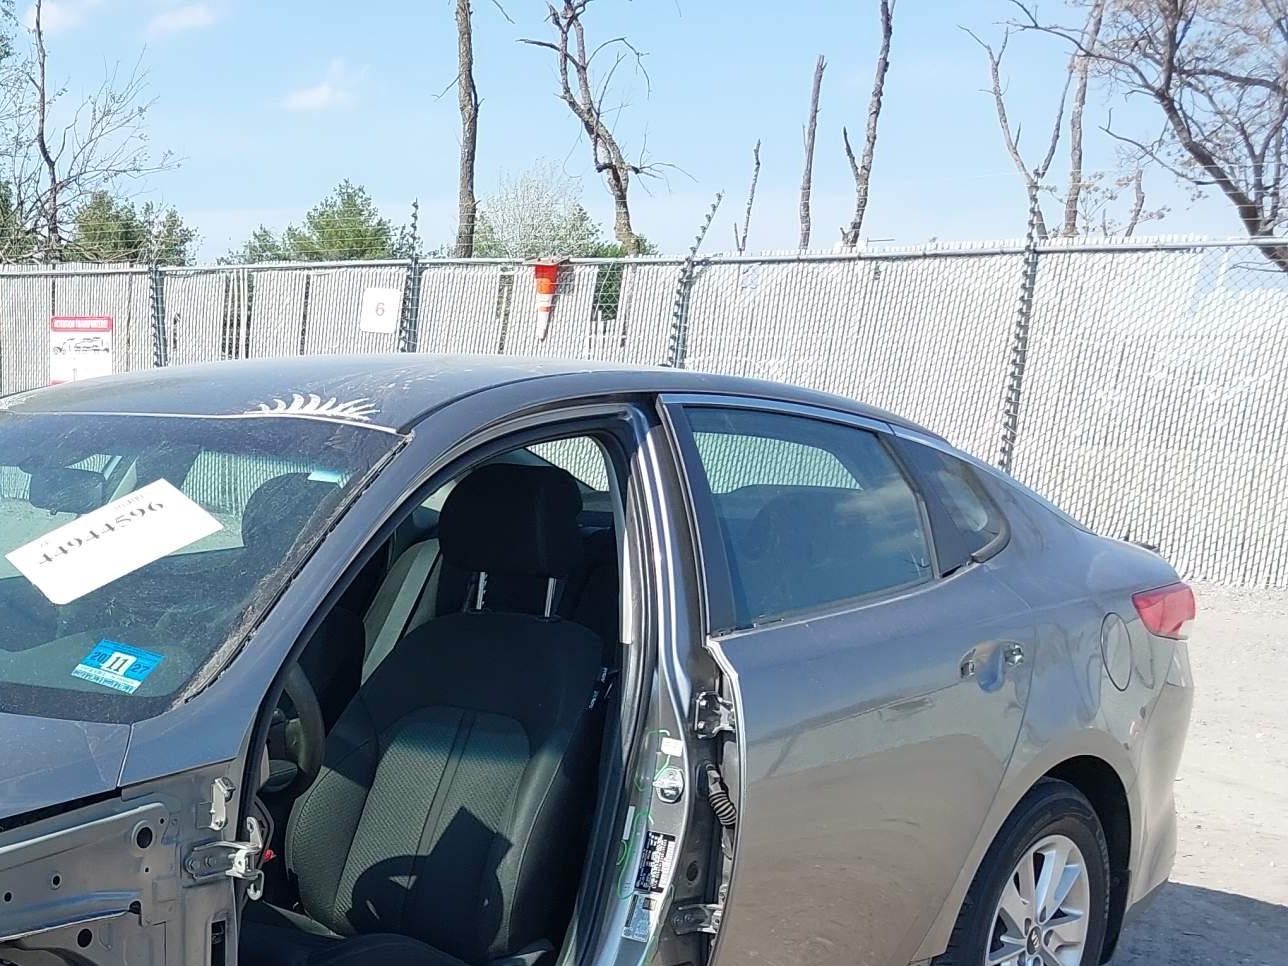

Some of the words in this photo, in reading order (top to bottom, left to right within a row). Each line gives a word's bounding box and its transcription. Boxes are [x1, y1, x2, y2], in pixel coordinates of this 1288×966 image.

[375, 302, 385, 317] 6
[105, 656, 129, 673] 11
[131, 663, 152, 674] 27
